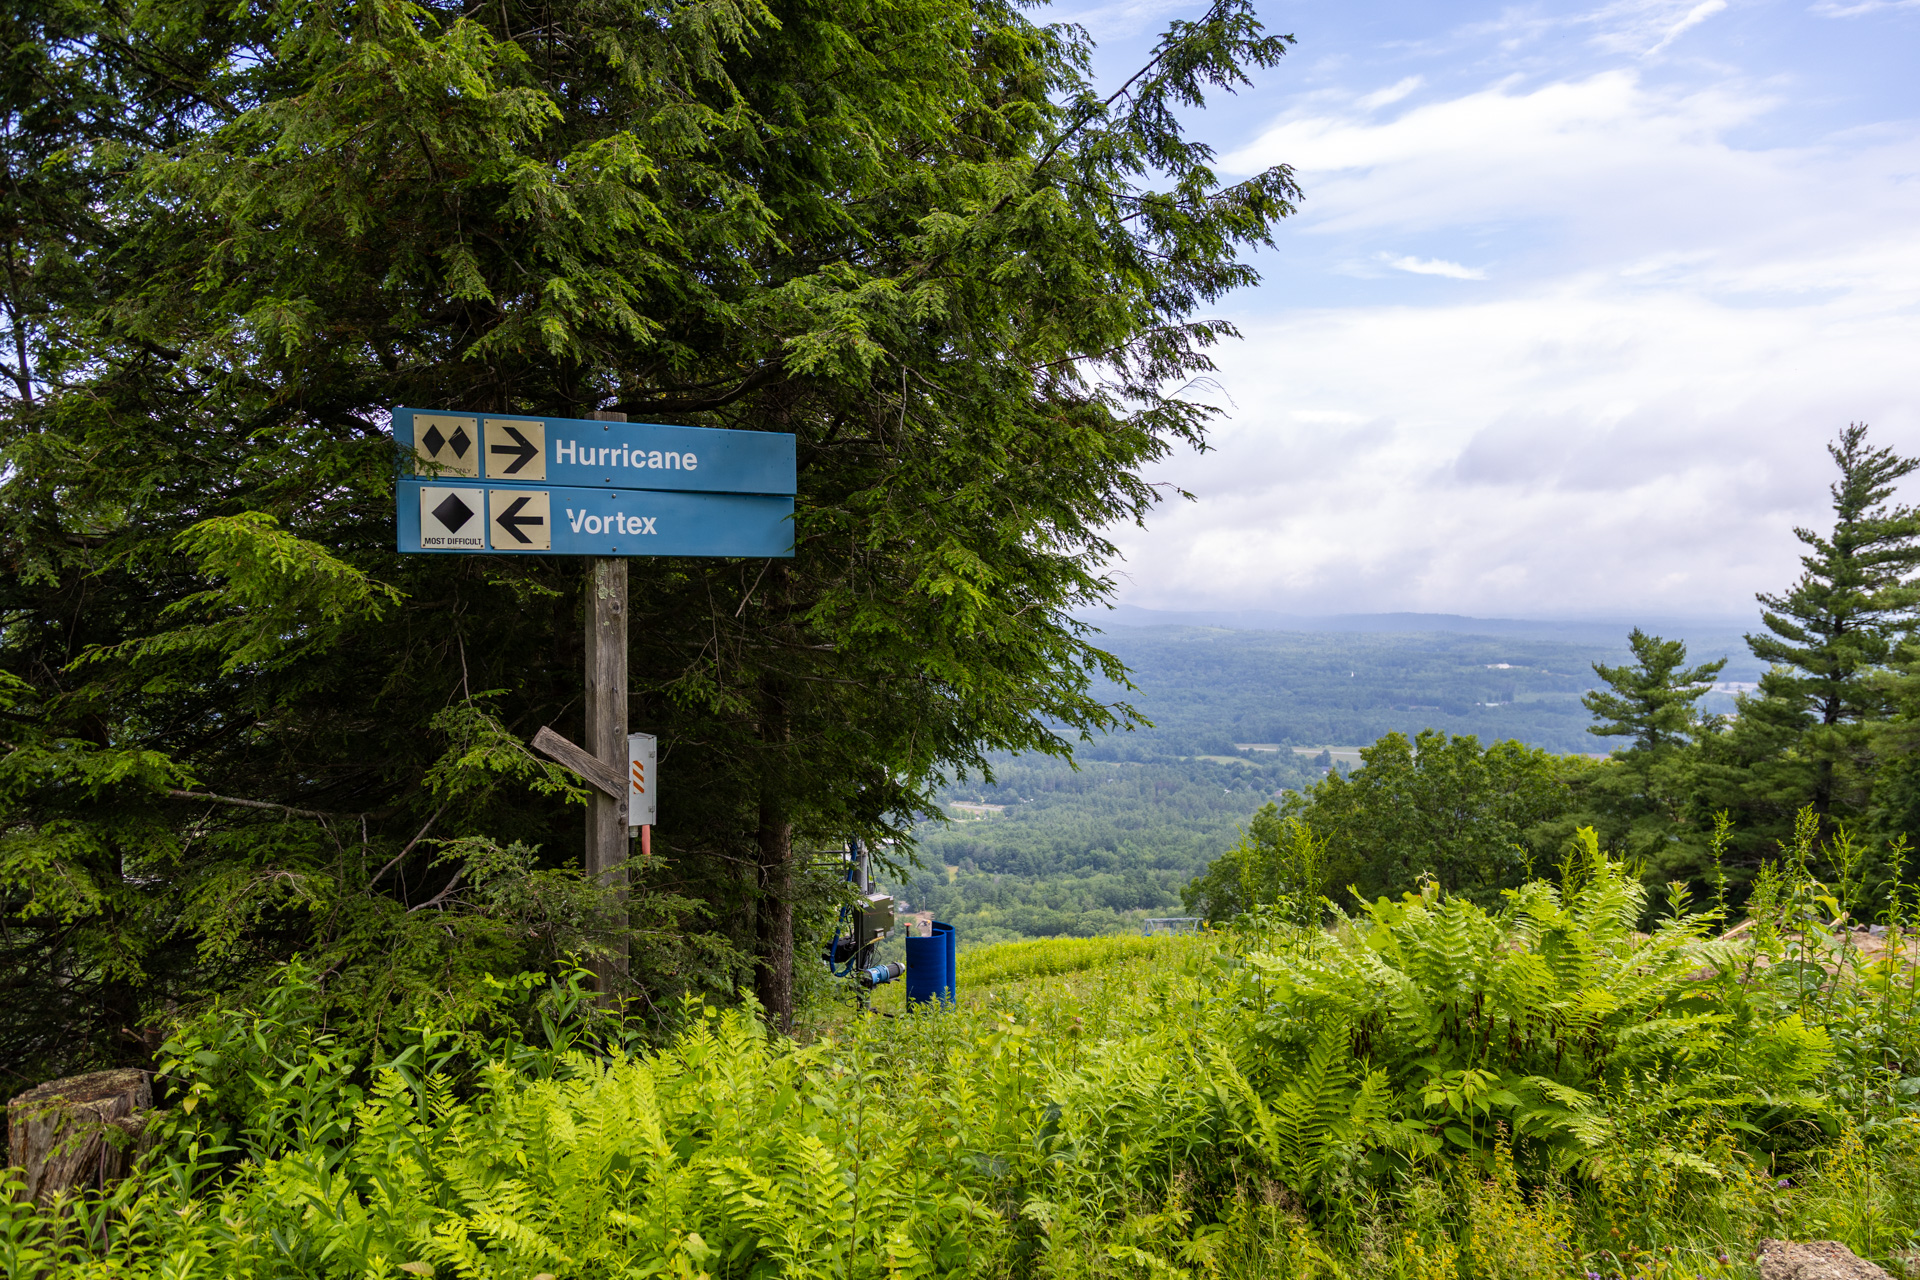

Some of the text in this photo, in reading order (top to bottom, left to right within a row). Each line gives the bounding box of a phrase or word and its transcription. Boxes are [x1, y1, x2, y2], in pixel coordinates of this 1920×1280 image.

[556, 439, 698, 471] Hurricane
[565, 508, 658, 535] Vortex
[424, 537, 482, 546] MOST DIFFICULT
